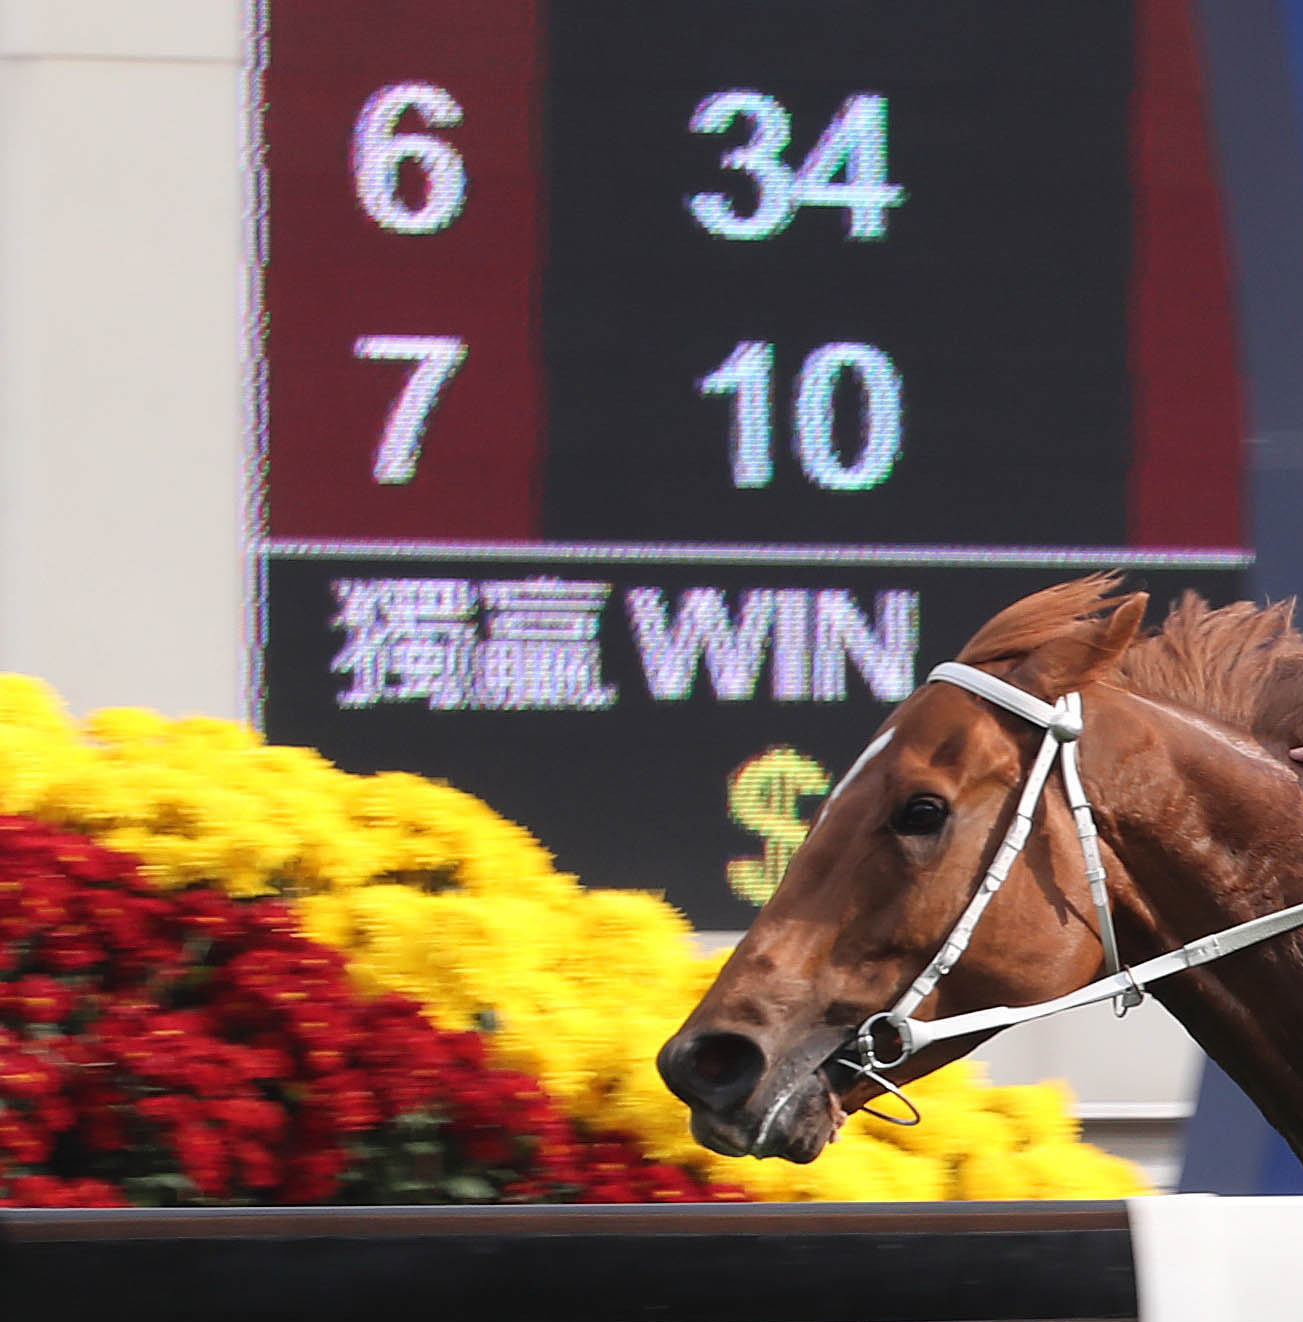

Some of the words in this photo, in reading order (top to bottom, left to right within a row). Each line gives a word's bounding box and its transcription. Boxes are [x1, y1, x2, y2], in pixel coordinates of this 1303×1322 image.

[353, 82, 466, 235] 6
[687, 88, 908, 241] 34
[353, 335, 467, 484] 7
[698, 341, 904, 491] 10
[626, 585, 921, 703] WIN
